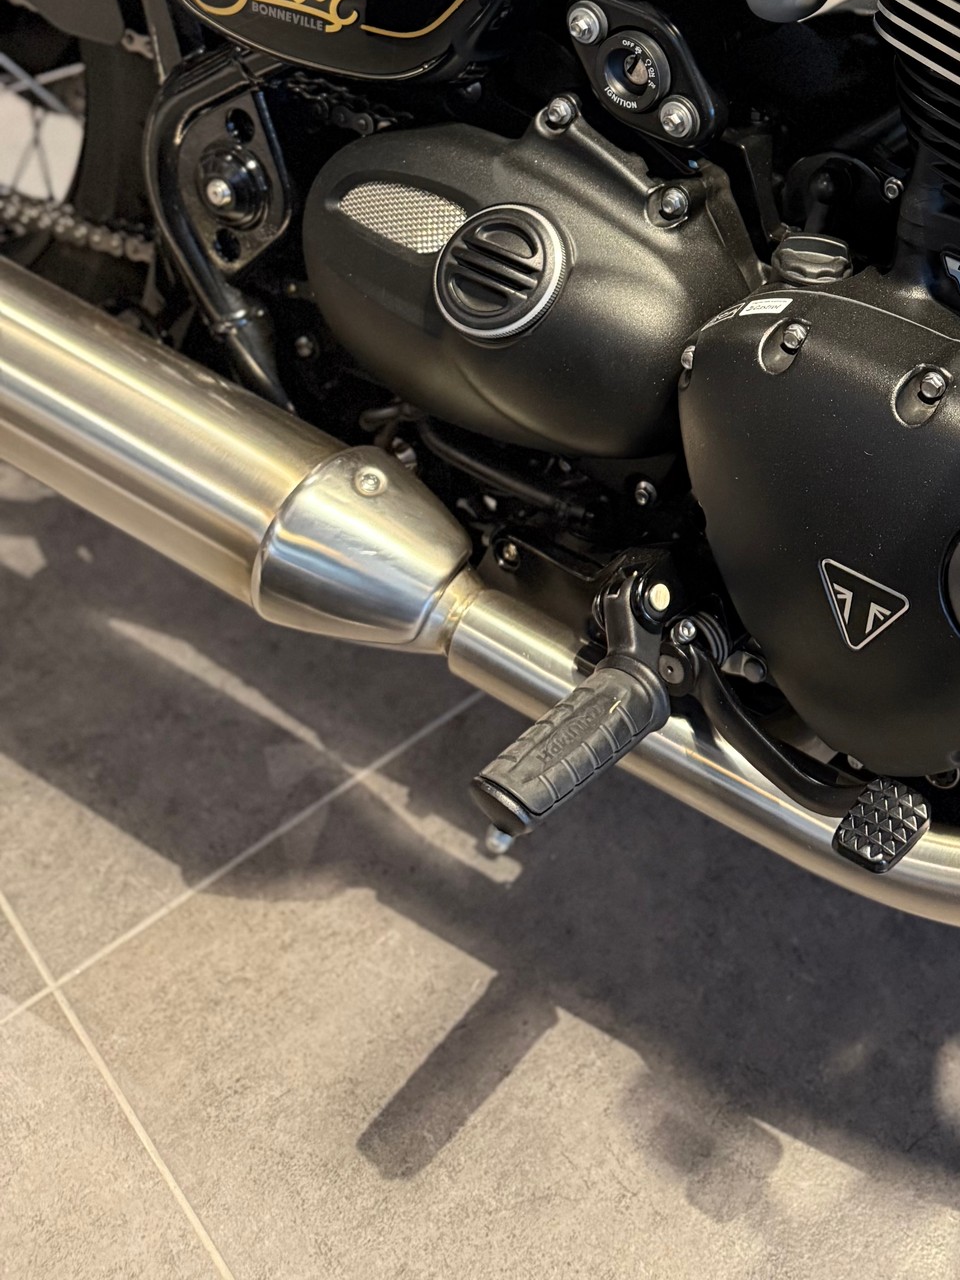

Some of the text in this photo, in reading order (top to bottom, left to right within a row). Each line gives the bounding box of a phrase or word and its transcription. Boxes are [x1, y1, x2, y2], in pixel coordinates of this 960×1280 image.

[251, 1, 324, 31] BONNEVILLE
[622, 39, 635, 48] OFF
[648, 67, 656, 78] ON
[604, 86, 638, 109] IGNITION
[535, 703, 606, 766] TRIUMPH
